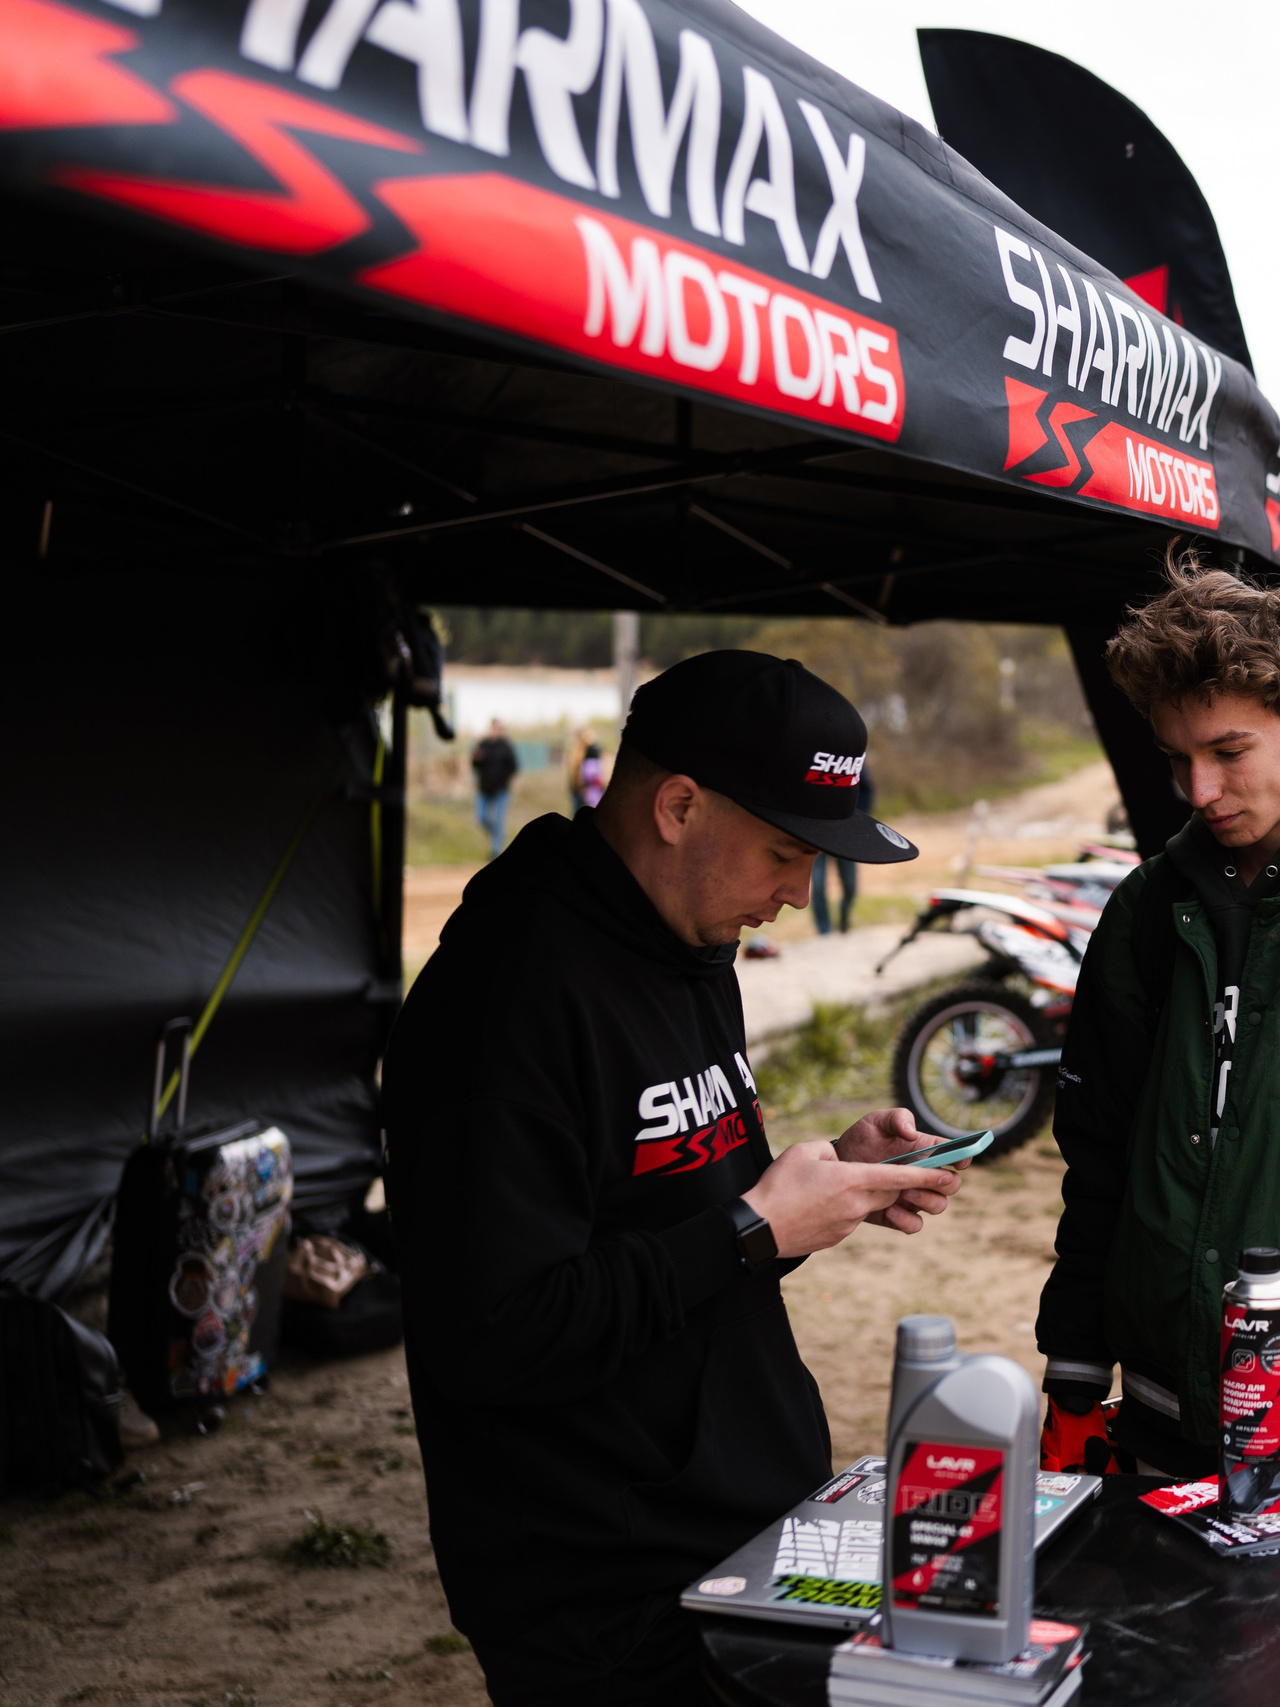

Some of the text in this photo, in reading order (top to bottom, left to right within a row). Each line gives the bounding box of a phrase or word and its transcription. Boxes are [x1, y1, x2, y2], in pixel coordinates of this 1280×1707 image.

[573, 213, 899, 425] MOTORS
[994, 226, 1222, 451] SHARMAX
[1126, 437, 1217, 521] MOTORS
[1224, 1314, 1270, 1333] LAVR
[1223, 1378, 1266, 1392] МАСЛО ДЛЯ
[926, 1454, 977, 1474] LAVR
